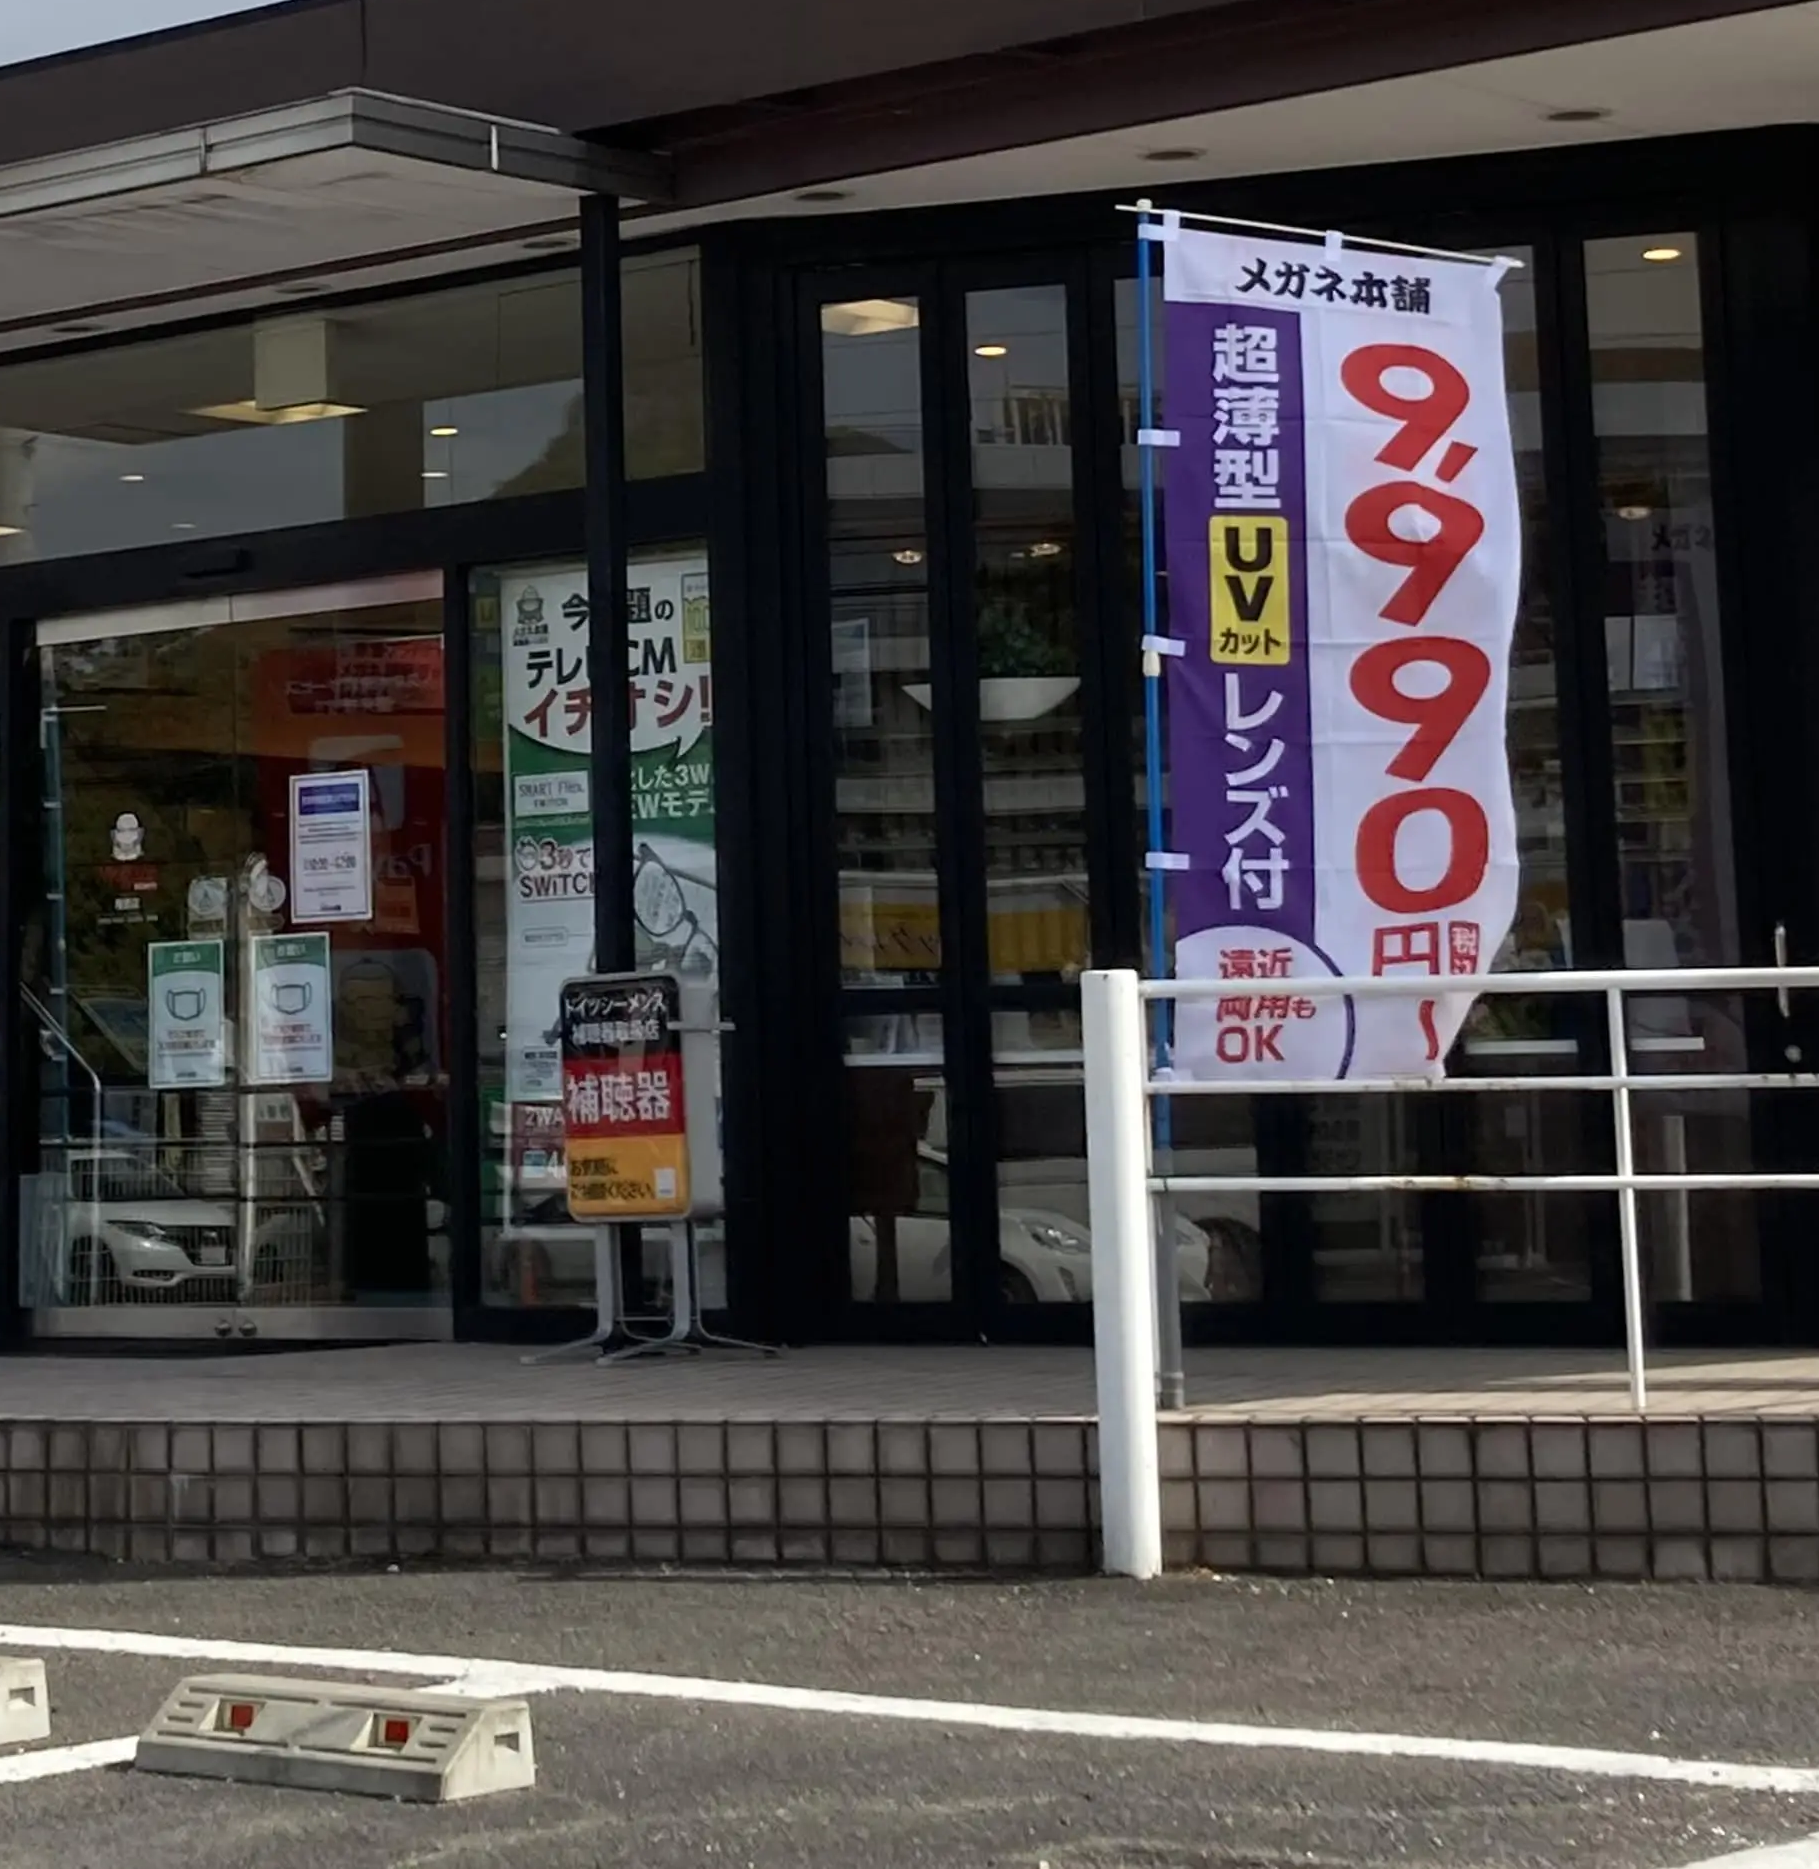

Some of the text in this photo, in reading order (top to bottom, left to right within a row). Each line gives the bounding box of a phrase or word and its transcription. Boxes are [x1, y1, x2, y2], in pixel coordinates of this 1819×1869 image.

[1234, 257, 1432, 317] メガネ本舗
[1212, 323, 1291, 911] 超薄型 UV カット レンズ付
[1215, 1026, 1287, 1063] OK
[566, 1070, 671, 1125] 補聴器
